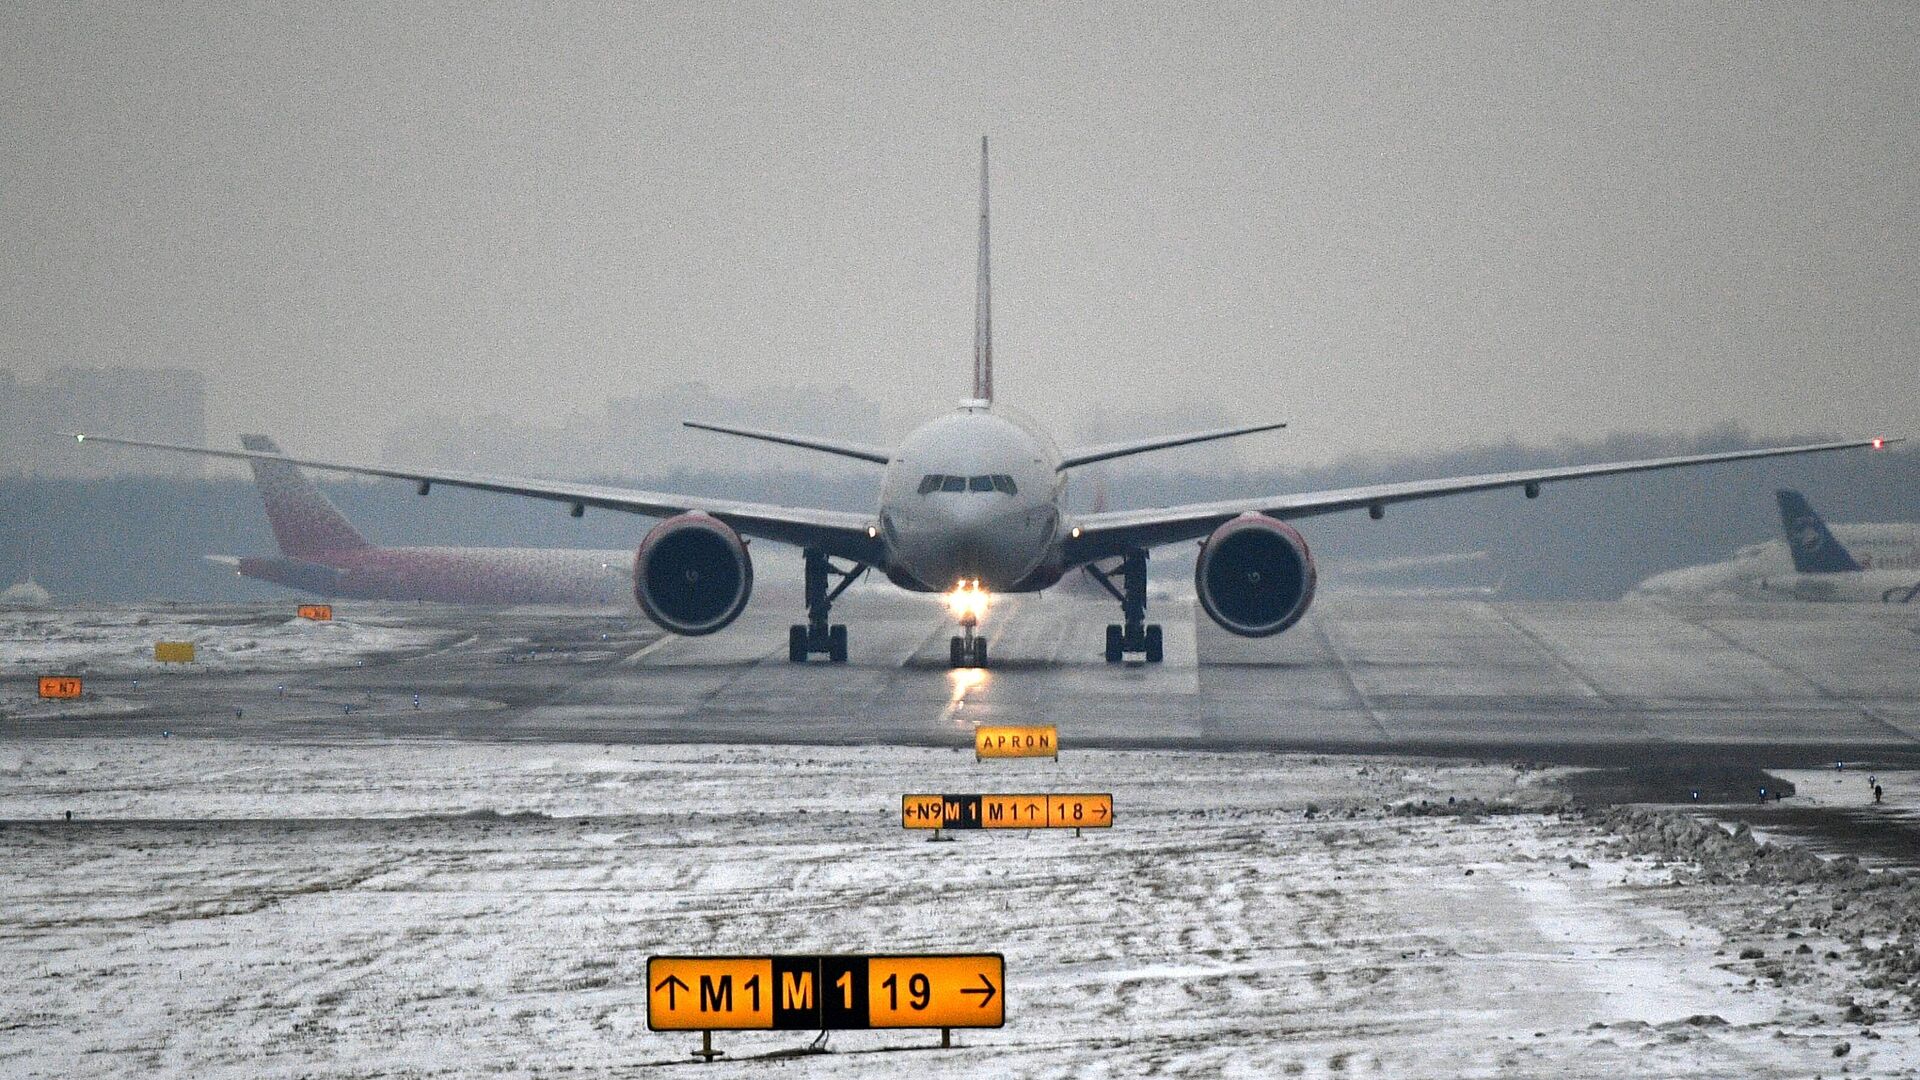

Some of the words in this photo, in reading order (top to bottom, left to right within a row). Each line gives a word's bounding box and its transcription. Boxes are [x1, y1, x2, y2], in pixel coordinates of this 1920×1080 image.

[60, 681, 75, 693] N7
[983, 735, 1049, 749] APRON
[917, 802, 942, 820] N9
[1058, 803, 1083, 820] 18
[700, 974, 760, 1012] M1
[882, 973, 930, 1011] 19
